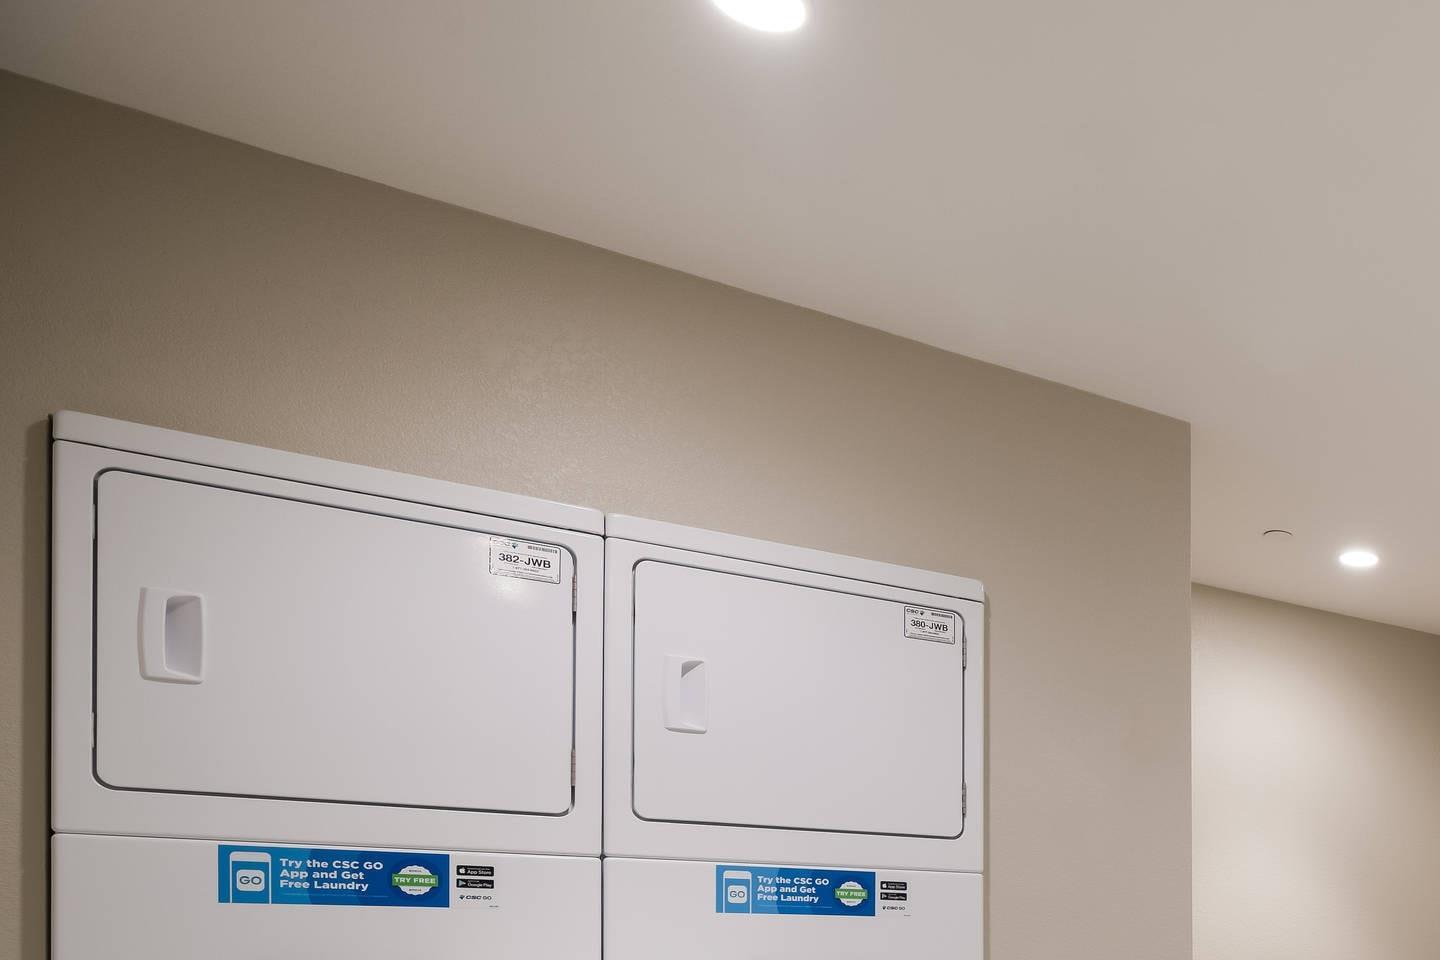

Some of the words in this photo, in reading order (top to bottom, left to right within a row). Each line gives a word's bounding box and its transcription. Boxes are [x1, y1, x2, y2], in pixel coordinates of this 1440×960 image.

[498, 552, 551, 569] 382-JWB
[910, 619, 949, 632] 380-JWB
[280, 858, 302, 868] Try
[306, 859, 328, 868] the
[332, 860, 359, 869] CSC
[363, 861, 384, 870] GO
[239, 875, 262, 885] GO
[280, 869, 308, 879] App
[312, 870, 337, 879] and
[341, 871, 365, 880] Get
[394, 876, 413, 884] TRY
[413, 876, 436, 884] FREE
[280, 879, 310, 889] Free
[314, 880, 369, 892] Laundry
[757, 875, 774, 884] Try
[776, 876, 791, 884] the
[793, 877, 812, 885] CSC
[815, 878, 830, 886] GO
[729, 890, 746, 898] GO
[757, 884, 777, 893] App
[780, 885, 797, 893] and
[799, 886, 816, 894] Get
[757, 893, 778, 901] Free
[780, 894, 819, 904] Laundry
